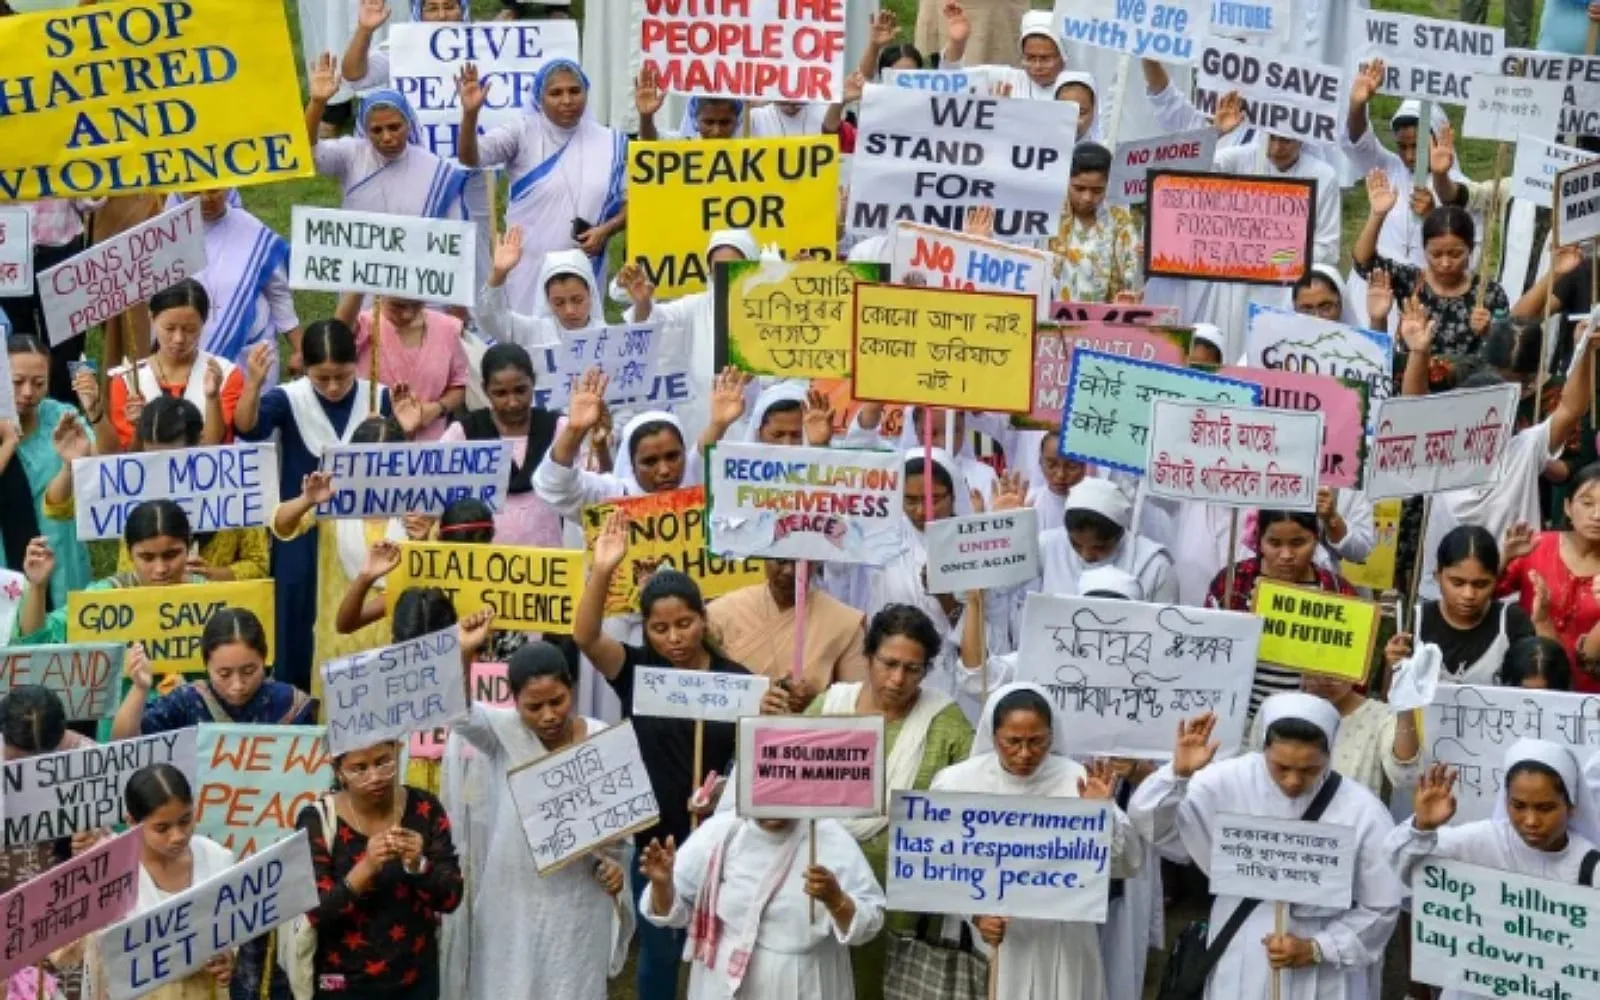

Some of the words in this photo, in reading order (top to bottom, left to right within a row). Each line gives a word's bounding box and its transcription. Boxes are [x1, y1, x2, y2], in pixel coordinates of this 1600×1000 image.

[46, 1, 193, 58] STOP
[1116, 0, 1147, 23] We
[1151, 4, 1189, 32] are
[1219, 2, 1273, 29] FUTURE
[430, 25, 543, 62] GIVE
[642, 20, 783, 58] PEOPLE
[792, 28, 844, 62] OF
[1063, 16, 1127, 48] with
[1132, 29, 1193, 58] you
[1366, 19, 1399, 46] WE
[1413, 24, 1494, 56] STAND
[0, 45, 237, 117] HATRED
[643, 60, 832, 100] MANIPUR
[1203, 48, 1260, 84] GOD
[1265, 61, 1338, 101] SAVE
[1501, 55, 1564, 81] GIVE
[931, 97, 997, 130] WE
[1197, 87, 1335, 141] MNIPUR
[1564, 85, 1577, 106] A
[66, 98, 197, 149] AND
[0, 133, 298, 200] VIOLENCE
[631, 147, 766, 184] SPEAK
[777, 144, 835, 180] UP
[865, 133, 984, 166] STAND
[1012, 146, 1058, 170] UP
[1126, 149, 1148, 165] NO
[1155, 143, 1201, 160] MORE
[914, 171, 995, 199] FOR
[703, 196, 784, 230] FOR
[852, 202, 1049, 236] MANIUR
[1176, 213, 1297, 240] FORGIVENESS
[52, 247, 122, 295] GUNS
[129, 208, 194, 262] DON'T
[305, 218, 406, 252] MANIPUR
[428, 231, 462, 258] WE
[1193, 240, 1267, 265] PEACE
[87, 256, 153, 302] SOLVE
[305, 258, 340, 282] ARE
[352, 261, 407, 288] WITH
[416, 270, 454, 296] YOU
[910, 236, 955, 273] NO
[967, 250, 1032, 291] HOPE
[927, 311, 976, 333] আশা
[100, 458, 145, 498] NO
[169, 448, 261, 493] MORE
[366, 451, 405, 477] THE
[408, 446, 502, 476] VIOLENCE
[724, 458, 898, 491] RECONCILIATION
[363, 488, 389, 514] IN
[737, 485, 890, 518] FORGIVENESS
[630, 513, 679, 546] NO
[958, 521, 988, 534] LET
[992, 517, 1015, 530] US
[959, 537, 1011, 553] UNITE
[409, 549, 569, 587] DIALOGUE
[941, 560, 977, 573] ONCE
[981, 555, 1026, 568] AGAIN
[78, 602, 134, 634] GOD
[480, 588, 573, 625] SILENCE
[1272, 595, 1294, 614] NO
[1300, 600, 1347, 623] HOPE,
[1263, 618, 1286, 635] NO
[1290, 624, 1354, 648] FUTURE
[42, 651, 111, 688] AND
[326, 655, 367, 685] WE
[379, 634, 457, 673] STAND
[337, 684, 368, 709] UP
[386, 667, 439, 698] FOR
[332, 694, 447, 741] MANIPUR
[36, 734, 179, 788] SOLIDARITY
[210, 734, 277, 772] WE
[762, 746, 777, 759] IN
[783, 746, 869, 761] SOLIDARITY
[56, 776, 119, 806] WITH
[758, 765, 796, 779] WITH
[802, 766, 871, 780] MANIPUR
[900, 796, 951, 822] The
[962, 806, 1106, 837] government
[895, 829, 933, 854] has
[941, 841, 954, 855] a
[962, 837, 1107, 873] responsibility
[924, 857, 986, 900] bring
[998, 868, 1084, 900] peace.
[123, 901, 192, 952] LIVE
[213, 860, 283, 918] AND
[1422, 900, 1482, 927] each
[1501, 881, 1588, 929] killing
[129, 933, 198, 989] LET
[212, 892, 280, 951] LIVE
[1416, 920, 1457, 958] lay
[1466, 935, 1545, 970] down
